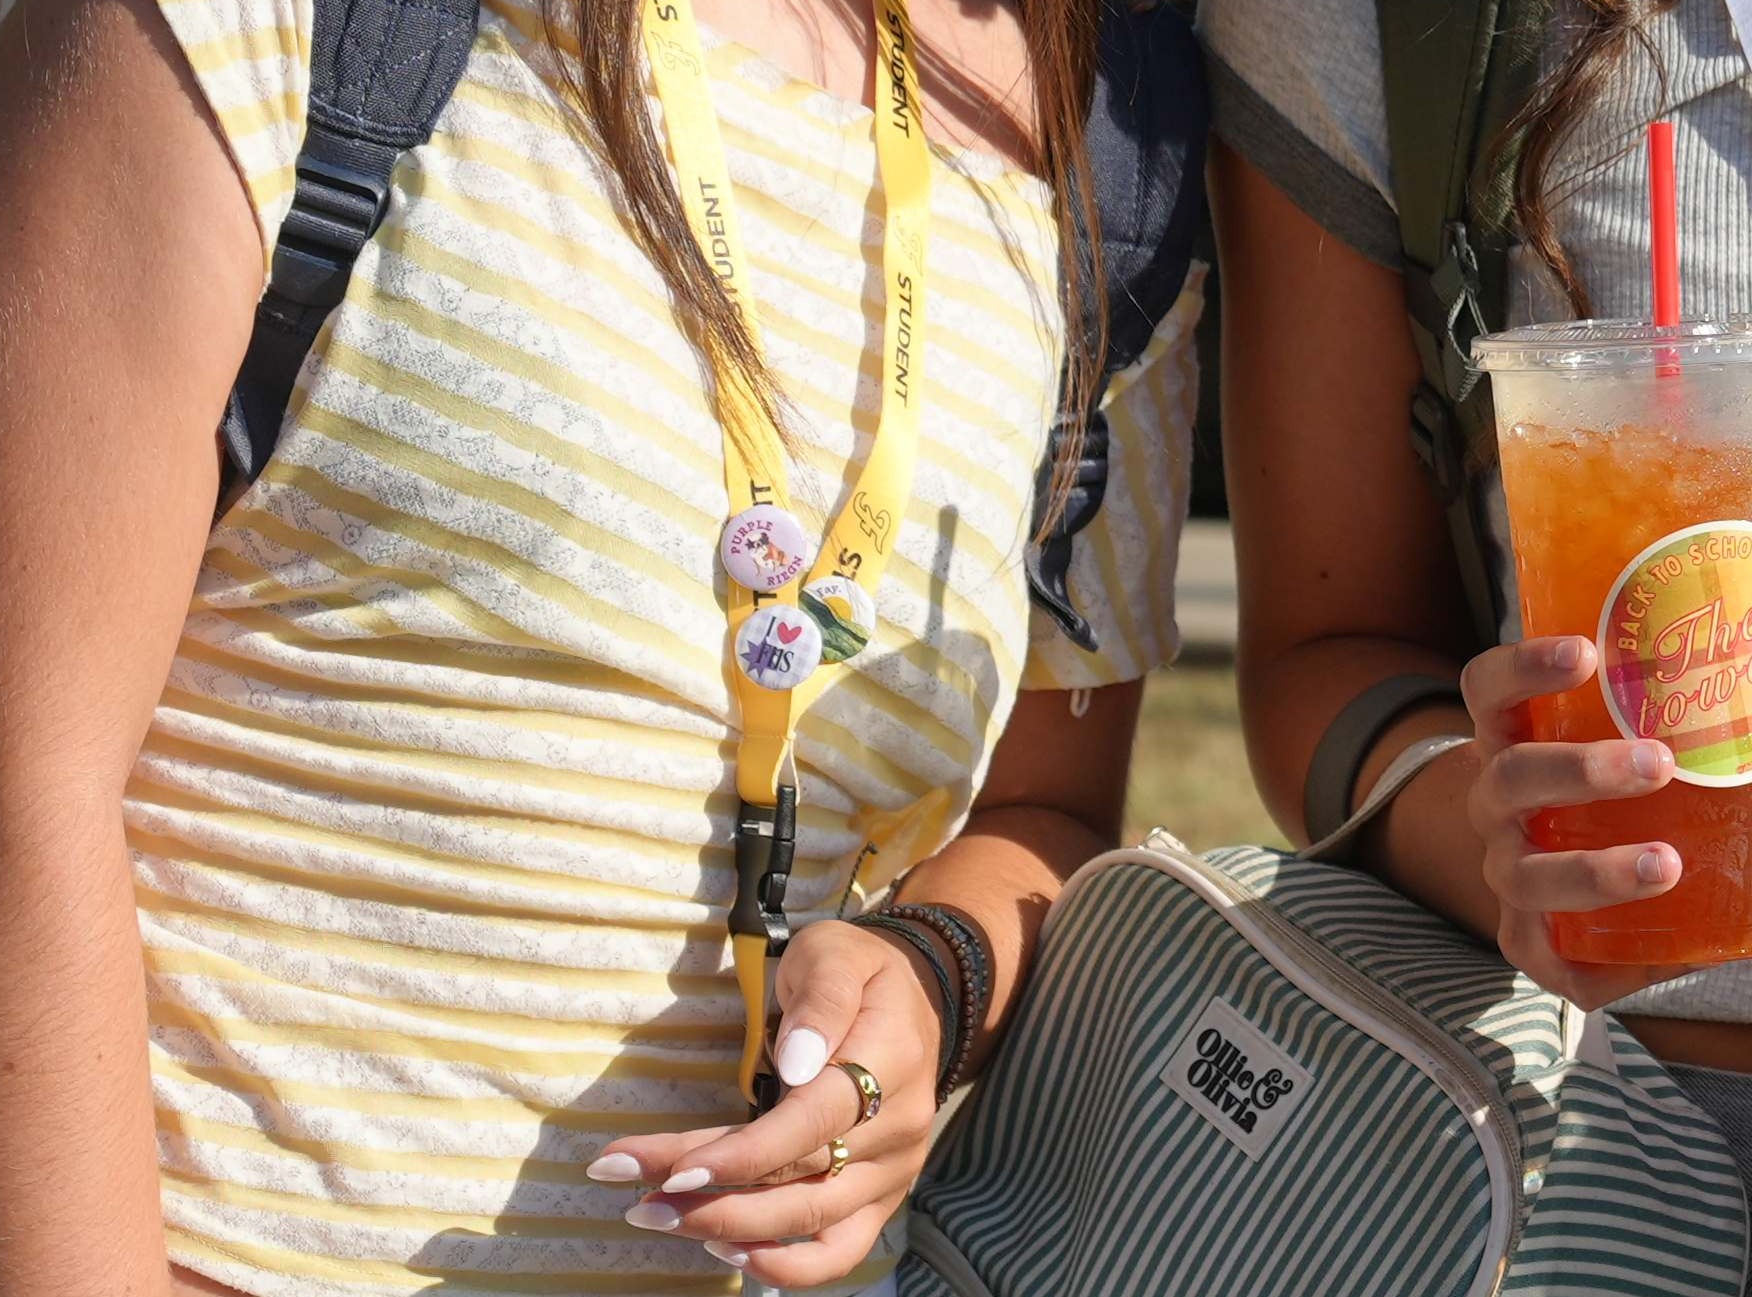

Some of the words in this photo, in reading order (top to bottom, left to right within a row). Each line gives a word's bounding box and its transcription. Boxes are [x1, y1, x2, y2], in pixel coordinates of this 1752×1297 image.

[886, 10, 910, 139] STUDENT
[895, 272, 913, 408] STUDENT
[730, 519, 774, 554] PURPLE
[766, 555, 803, 587] RIEGN
[766, 615, 777, 637] I
[1617, 584, 1657, 651] BACK
[1650, 554, 1683, 586] TO
[1186, 1058, 1258, 1135] Olivia
[1196, 1028, 1255, 1090] Ollie
[1250, 1068, 1294, 1110] &
